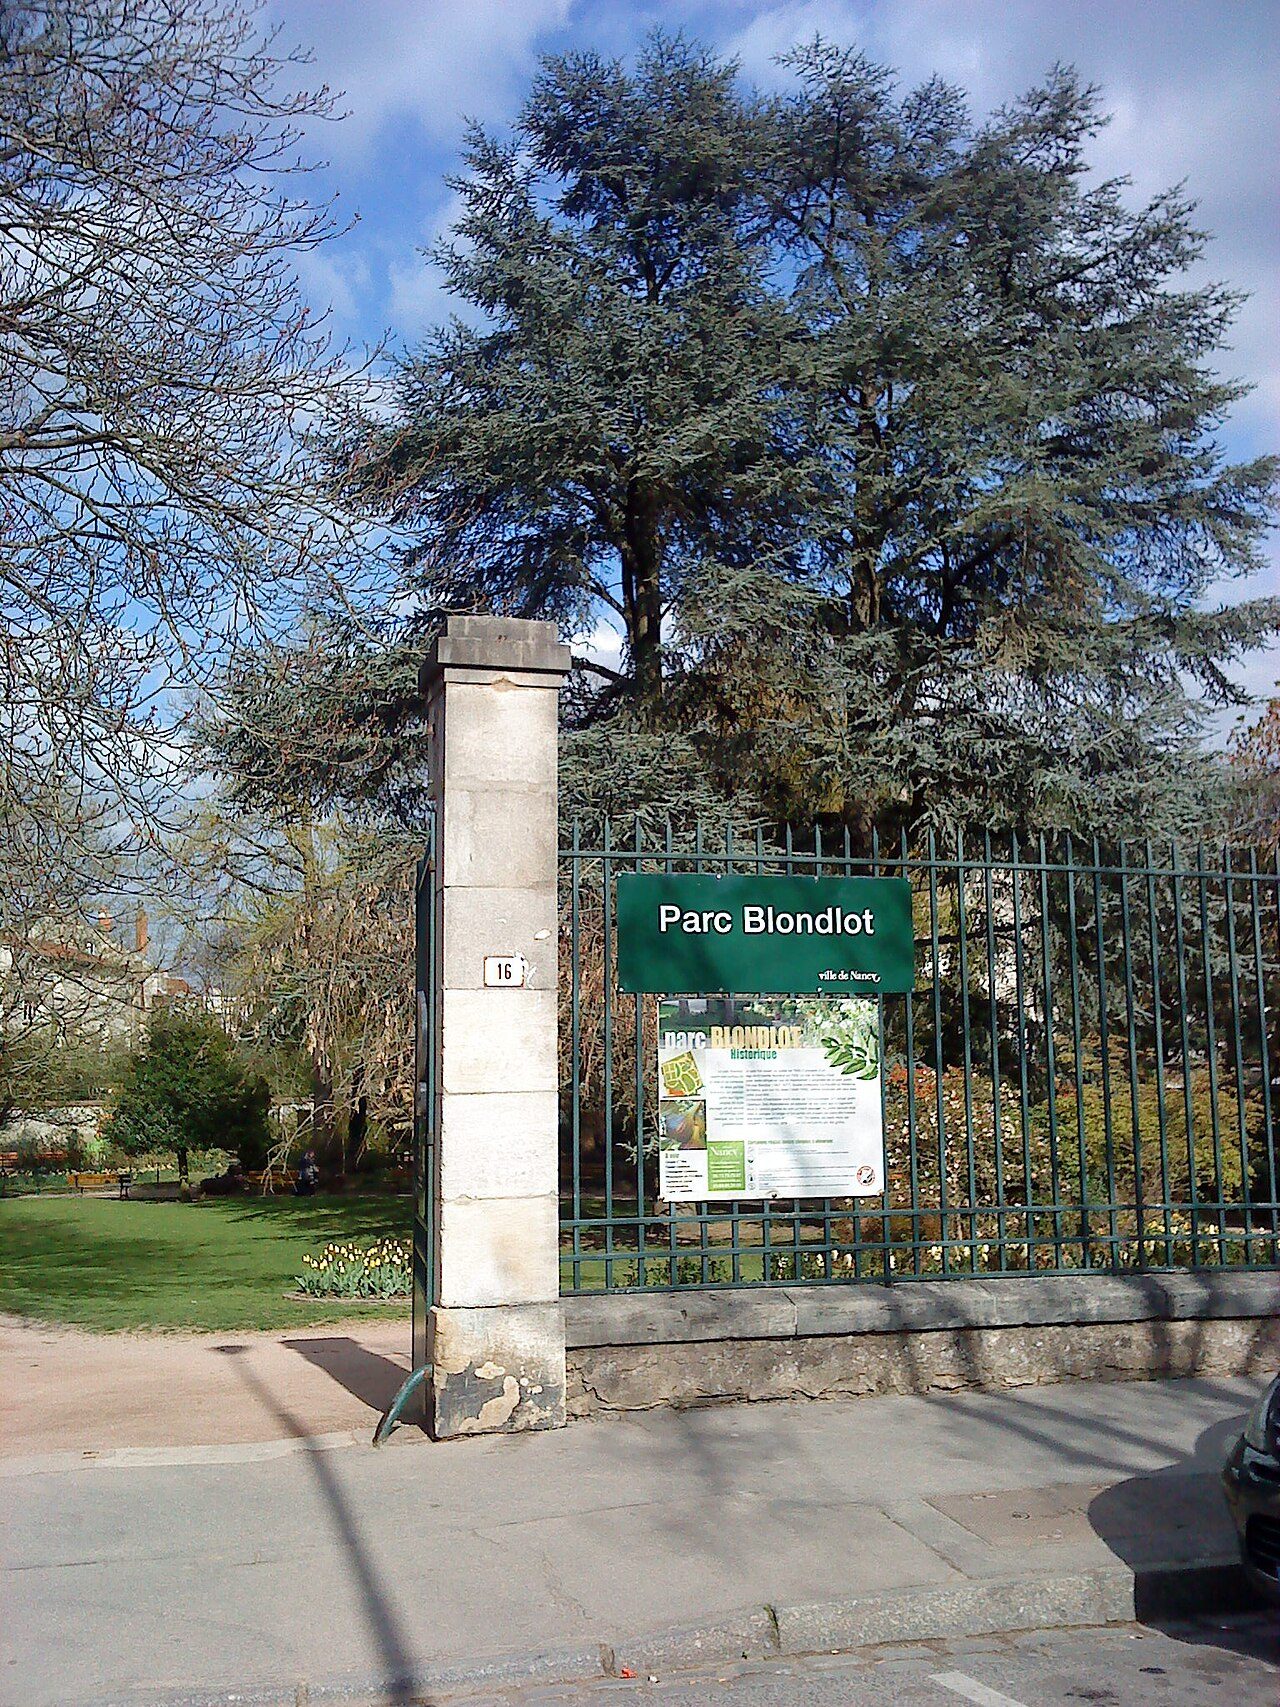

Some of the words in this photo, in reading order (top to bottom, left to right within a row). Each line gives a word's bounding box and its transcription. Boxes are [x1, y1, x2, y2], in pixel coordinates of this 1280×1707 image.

[659, 905, 732, 933] Parc
[743, 906, 874, 934] Blondlot
[498, 963, 511, 979] 16
[818, 970, 837, 980] ville
[838, 970, 849, 980] de
[850, 970, 880, 982] Nancy
[664, 1030, 706, 1050] parc
[711, 1026, 802, 1050] BLONDLOT
[730, 1049, 777, 1060] Historique
